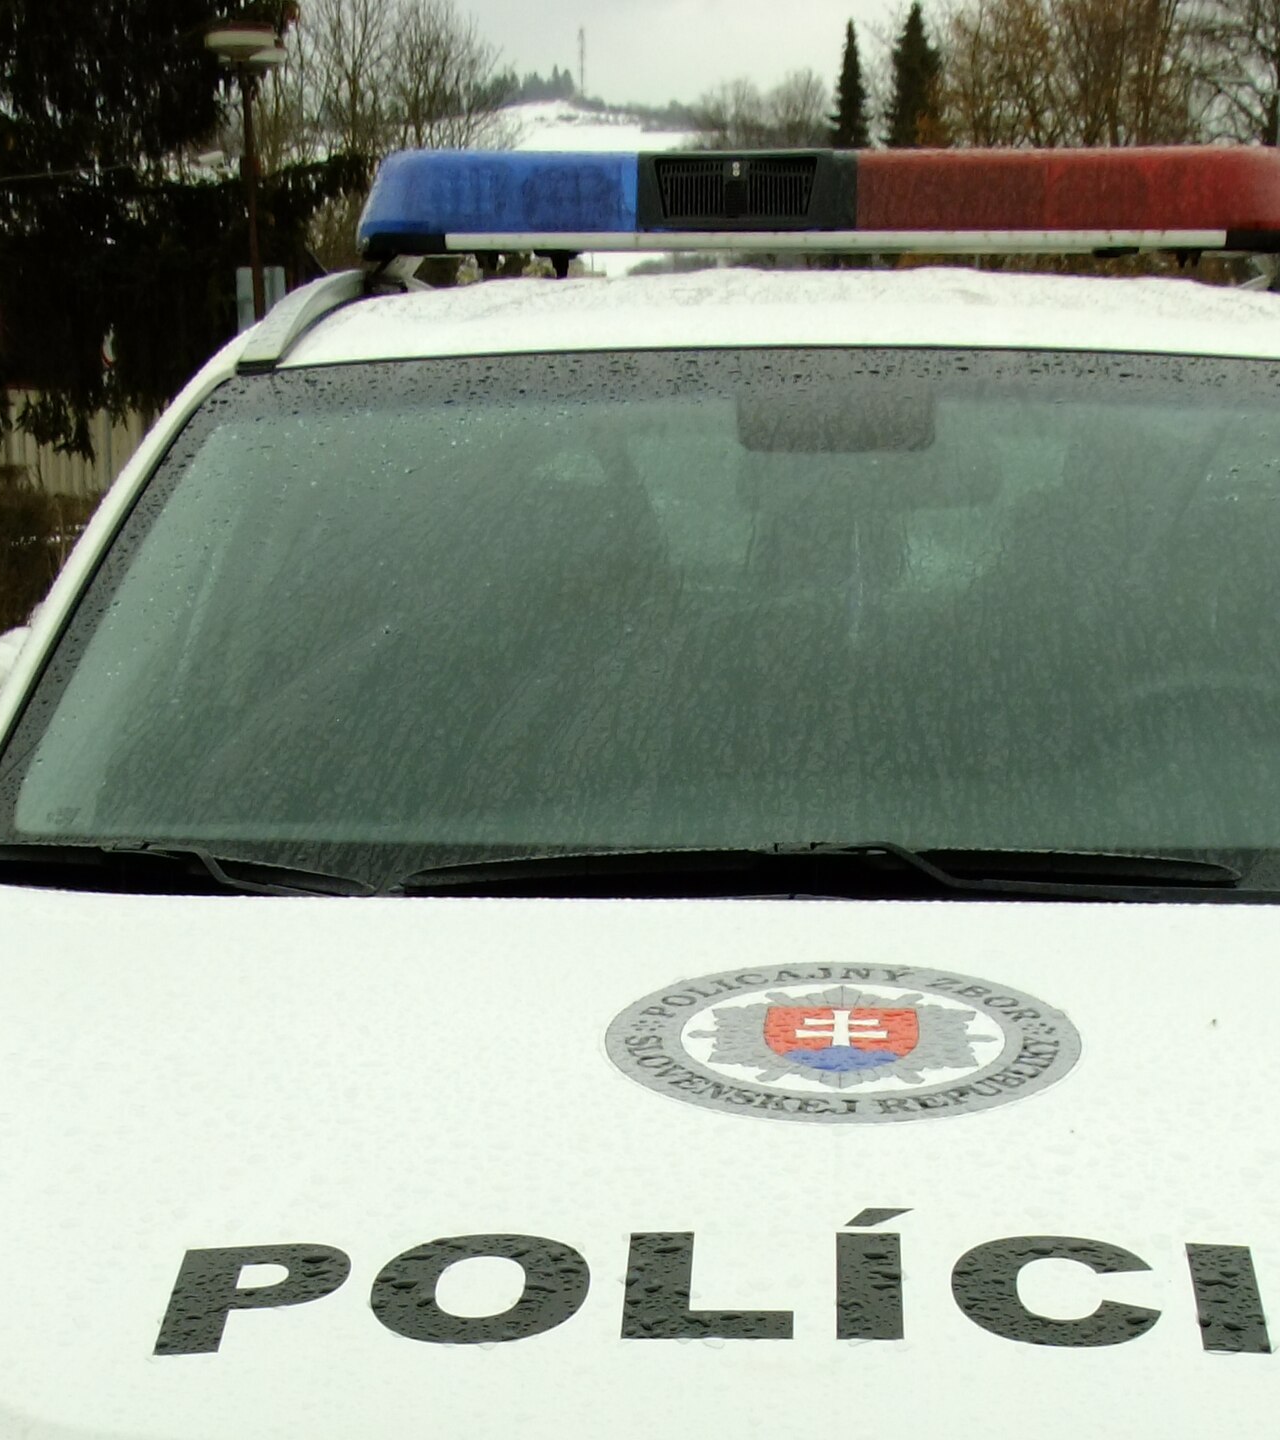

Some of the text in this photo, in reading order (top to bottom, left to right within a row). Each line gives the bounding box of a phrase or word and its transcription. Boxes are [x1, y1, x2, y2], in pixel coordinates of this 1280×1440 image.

[925, 977, 1041, 1023] ZBOR
[625, 1034, 1059, 1114] SLOVENSKEJ REPUBLIKY
